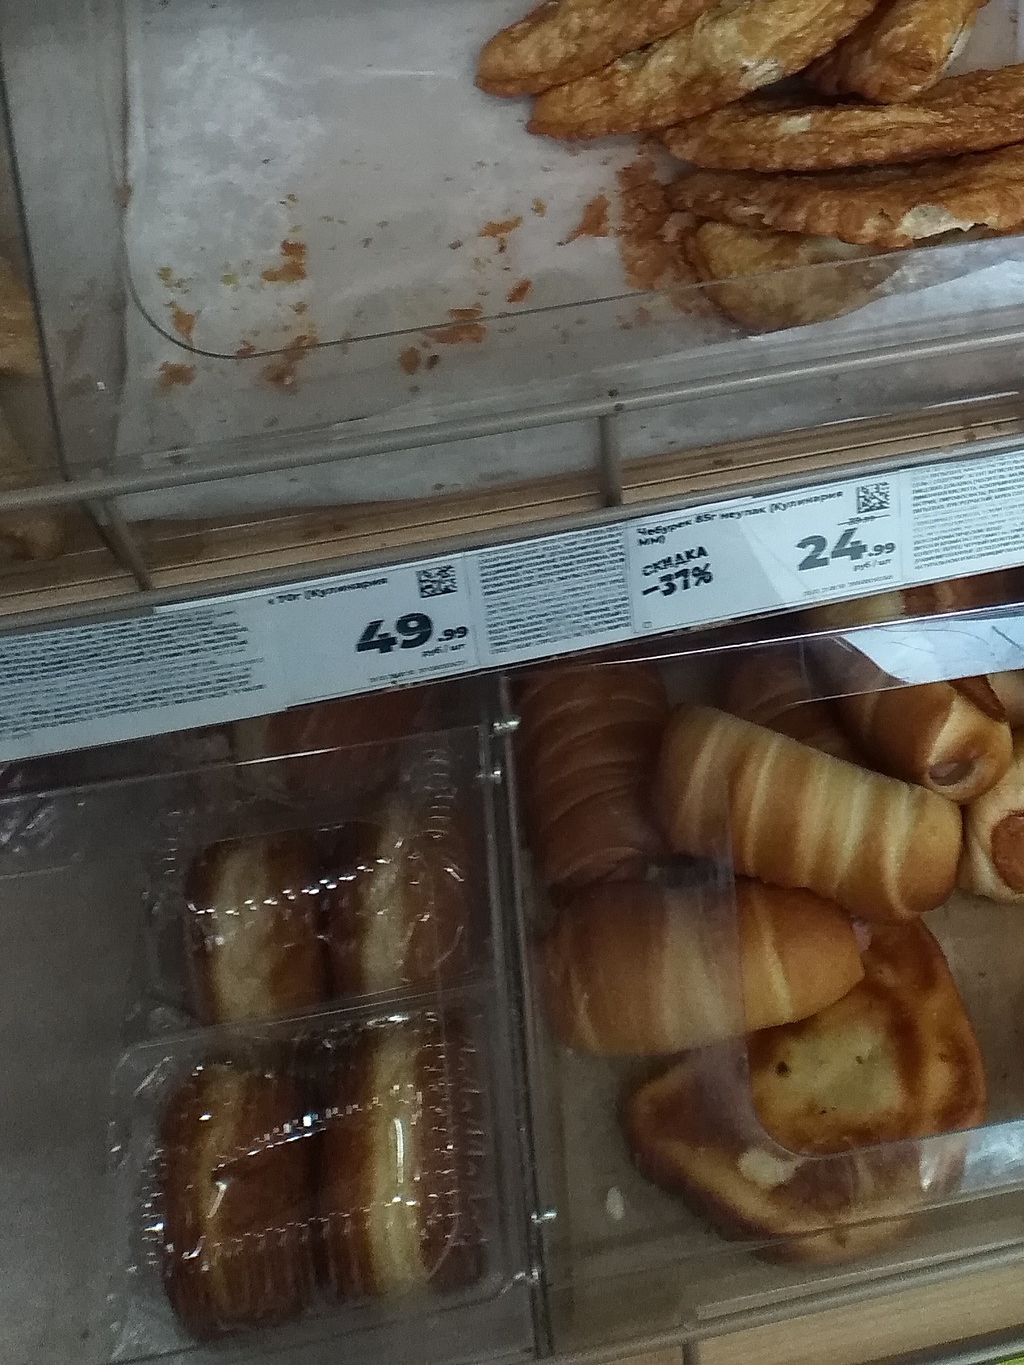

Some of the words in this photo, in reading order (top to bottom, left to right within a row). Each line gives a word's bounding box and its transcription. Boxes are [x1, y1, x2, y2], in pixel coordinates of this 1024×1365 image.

[636, 518, 692, 536] Чебурек
[770, 490, 843, 513] (Кулинария
[642, 546, 709, 577] СКИДКА
